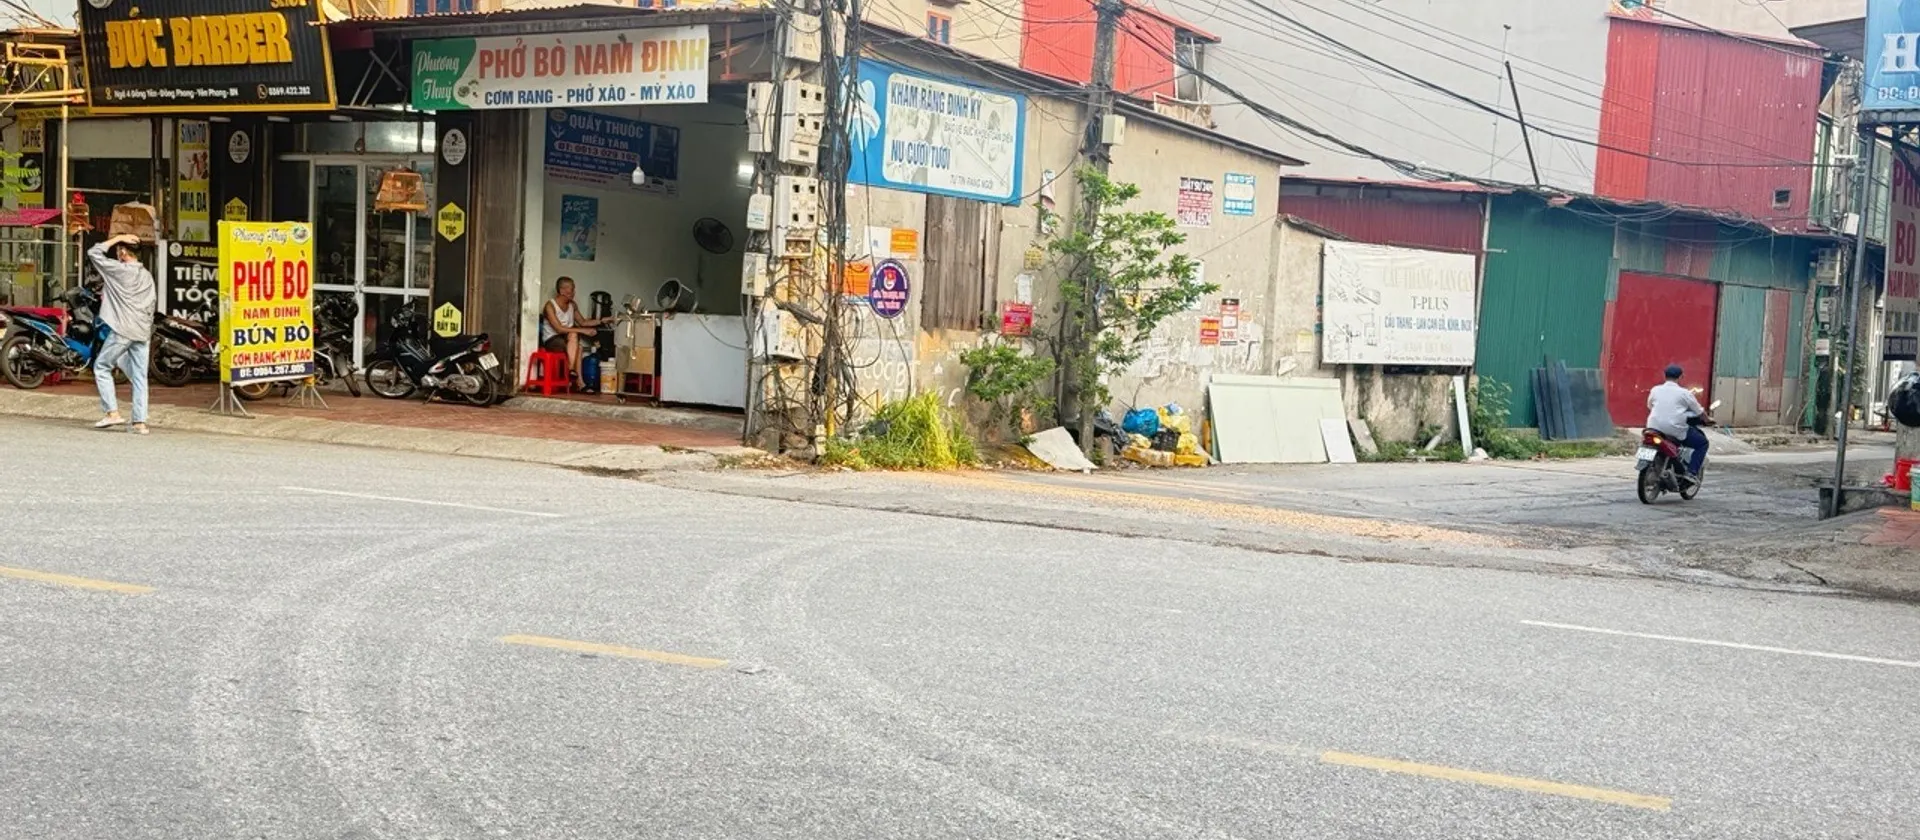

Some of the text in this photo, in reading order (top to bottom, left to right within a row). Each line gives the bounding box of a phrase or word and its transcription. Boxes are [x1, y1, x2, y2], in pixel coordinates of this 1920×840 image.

[105, 6, 293, 68] ĐỨC BARBER
[1881, 33, 1920, 72] H
[479, 37, 707, 79] PHỞ BÒ NAM ĐỊNH
[485, 89, 514, 105] CƠM
[518, 89, 553, 104] RANG
[567, 83, 594, 103] PHỞ
[599, 83, 625, 102] XÀO
[640, 82, 662, 100] MỲ
[667, 81, 695, 100] XÀO
[891, 79, 918, 107] KHÁM
[921, 85, 945, 113] RĂNG
[947, 92, 968, 121] ĐỊNH
[1894, 212, 1916, 266] BÒ
[234, 246, 308, 302] PHỞ BÒ
[243, 306, 300, 320] NAM ĐỊNH
[1411, 296, 1449, 311] T-PLUS
[233, 320, 310, 346] BÚN BÒ
